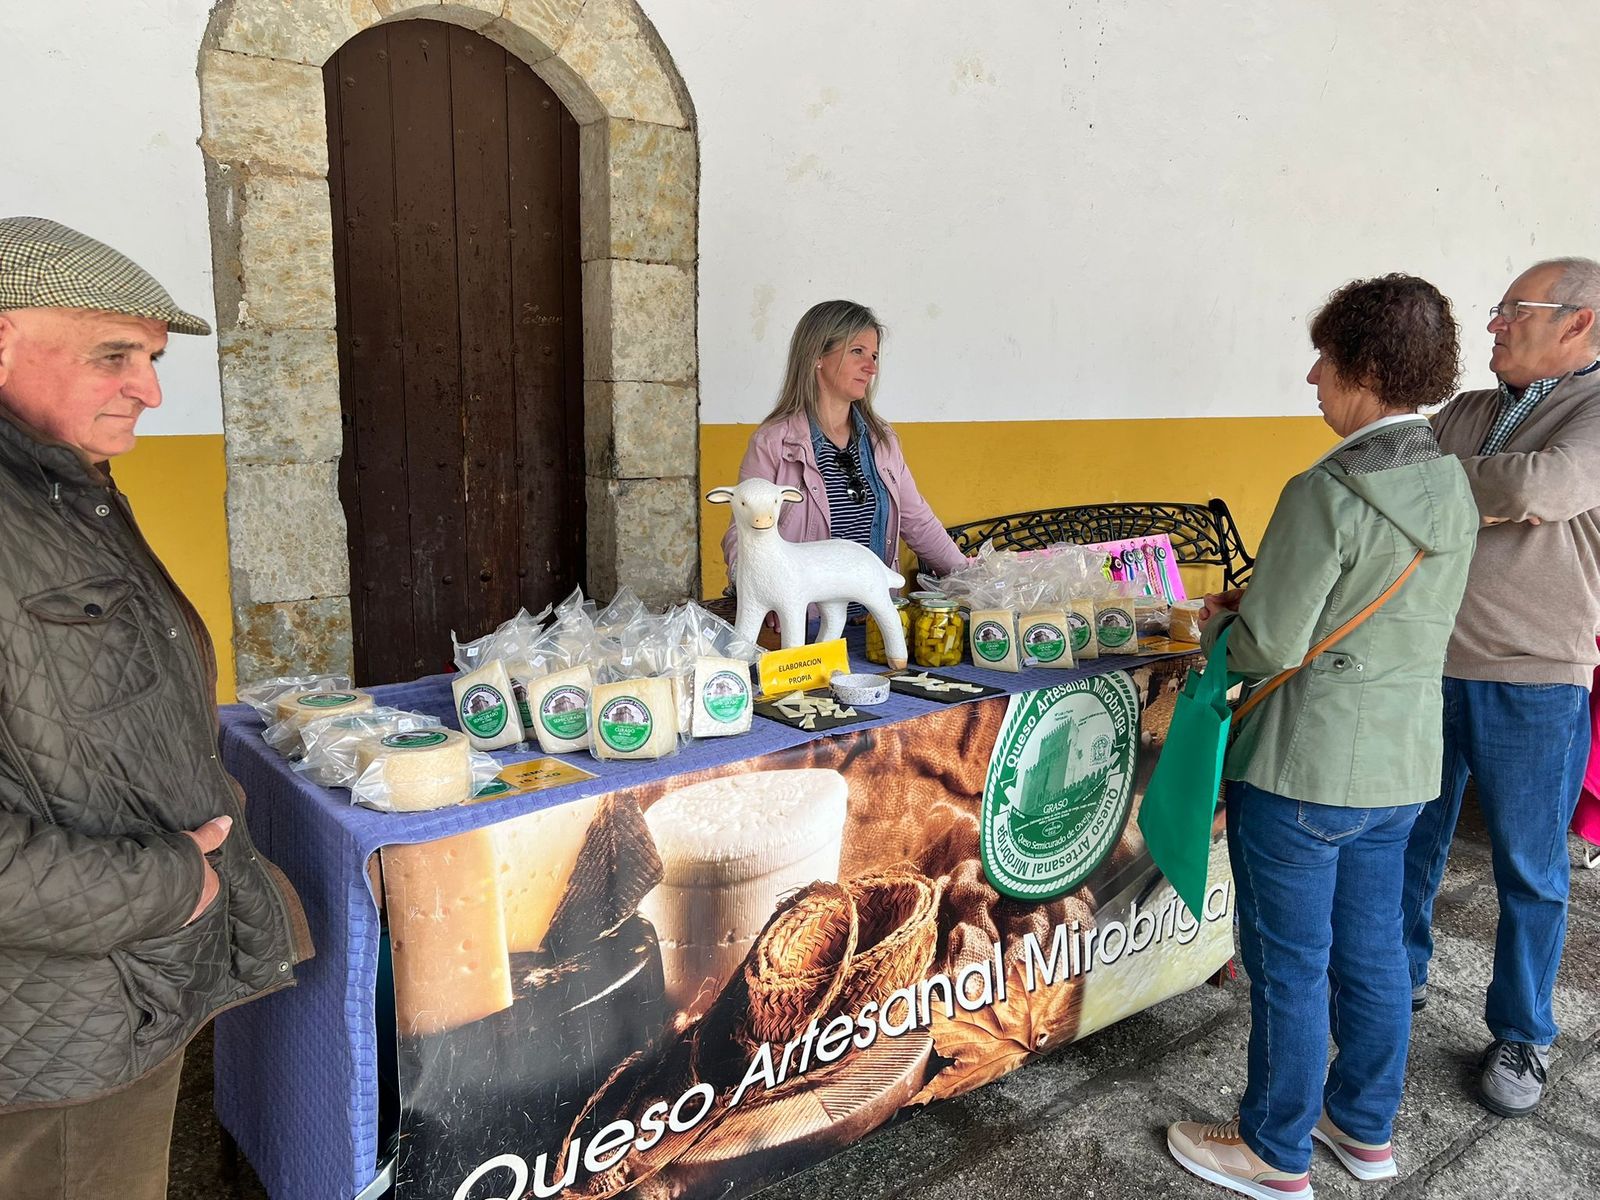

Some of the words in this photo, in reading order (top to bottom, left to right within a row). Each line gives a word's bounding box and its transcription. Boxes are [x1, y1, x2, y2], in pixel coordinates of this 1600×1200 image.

[778, 657, 822, 673] ELABORACION
[788, 674, 813, 685] PROPIA
[1006, 715, 1037, 768] Queso
[1036, 678, 1090, 717] Artesanal
[1093, 677, 1127, 737] Miróbriga
[1043, 797, 1068, 814] GRASO
[1092, 788, 1118, 836] Queso
[1017, 833, 1032, 848] Queso
[1031, 835, 1066, 850] Semicurado
[1066, 829, 1075, 839] de
[1074, 811, 1092, 832] Oveja
[1031, 836, 1090, 878] Artesanal
[452, 1082, 716, 1200] Queso
[728, 941, 1006, 1108] Artesanal
[1023, 879, 1231, 992] Mirobriga
